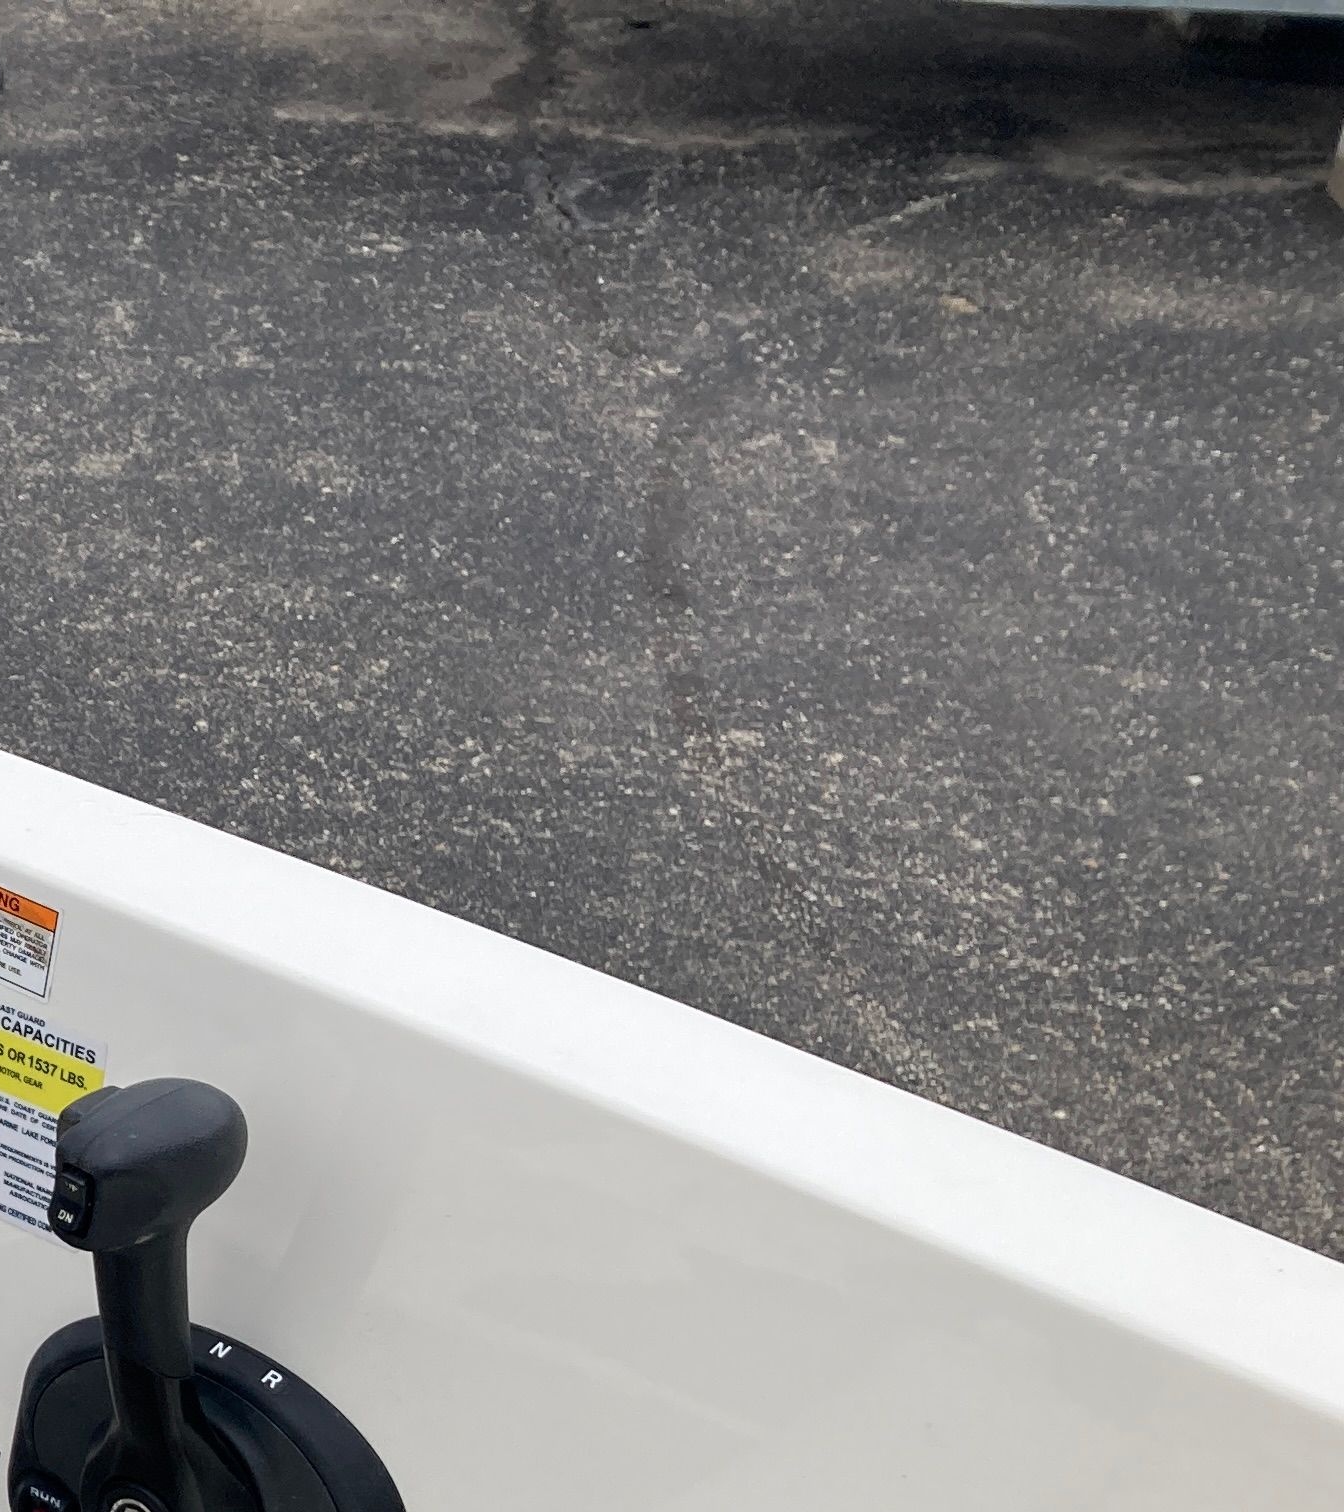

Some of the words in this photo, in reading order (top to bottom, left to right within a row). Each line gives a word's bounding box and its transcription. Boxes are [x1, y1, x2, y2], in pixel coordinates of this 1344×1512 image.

[17, 1010, 45, 1027] GUARD
[0, 1014, 96, 1064] CAPACITIES
[7, 1046, 25, 1065] OR
[28, 1054, 57, 1078] 1537
[59, 1067, 88, 1090] LBS.
[23, 1075, 42, 1089] GEAR
[57, 1209, 74, 1224] DN
[209, 1341, 232, 1359] N
[261, 1369, 283, 1389] R
[30, 1486, 60, 1508] RUN
